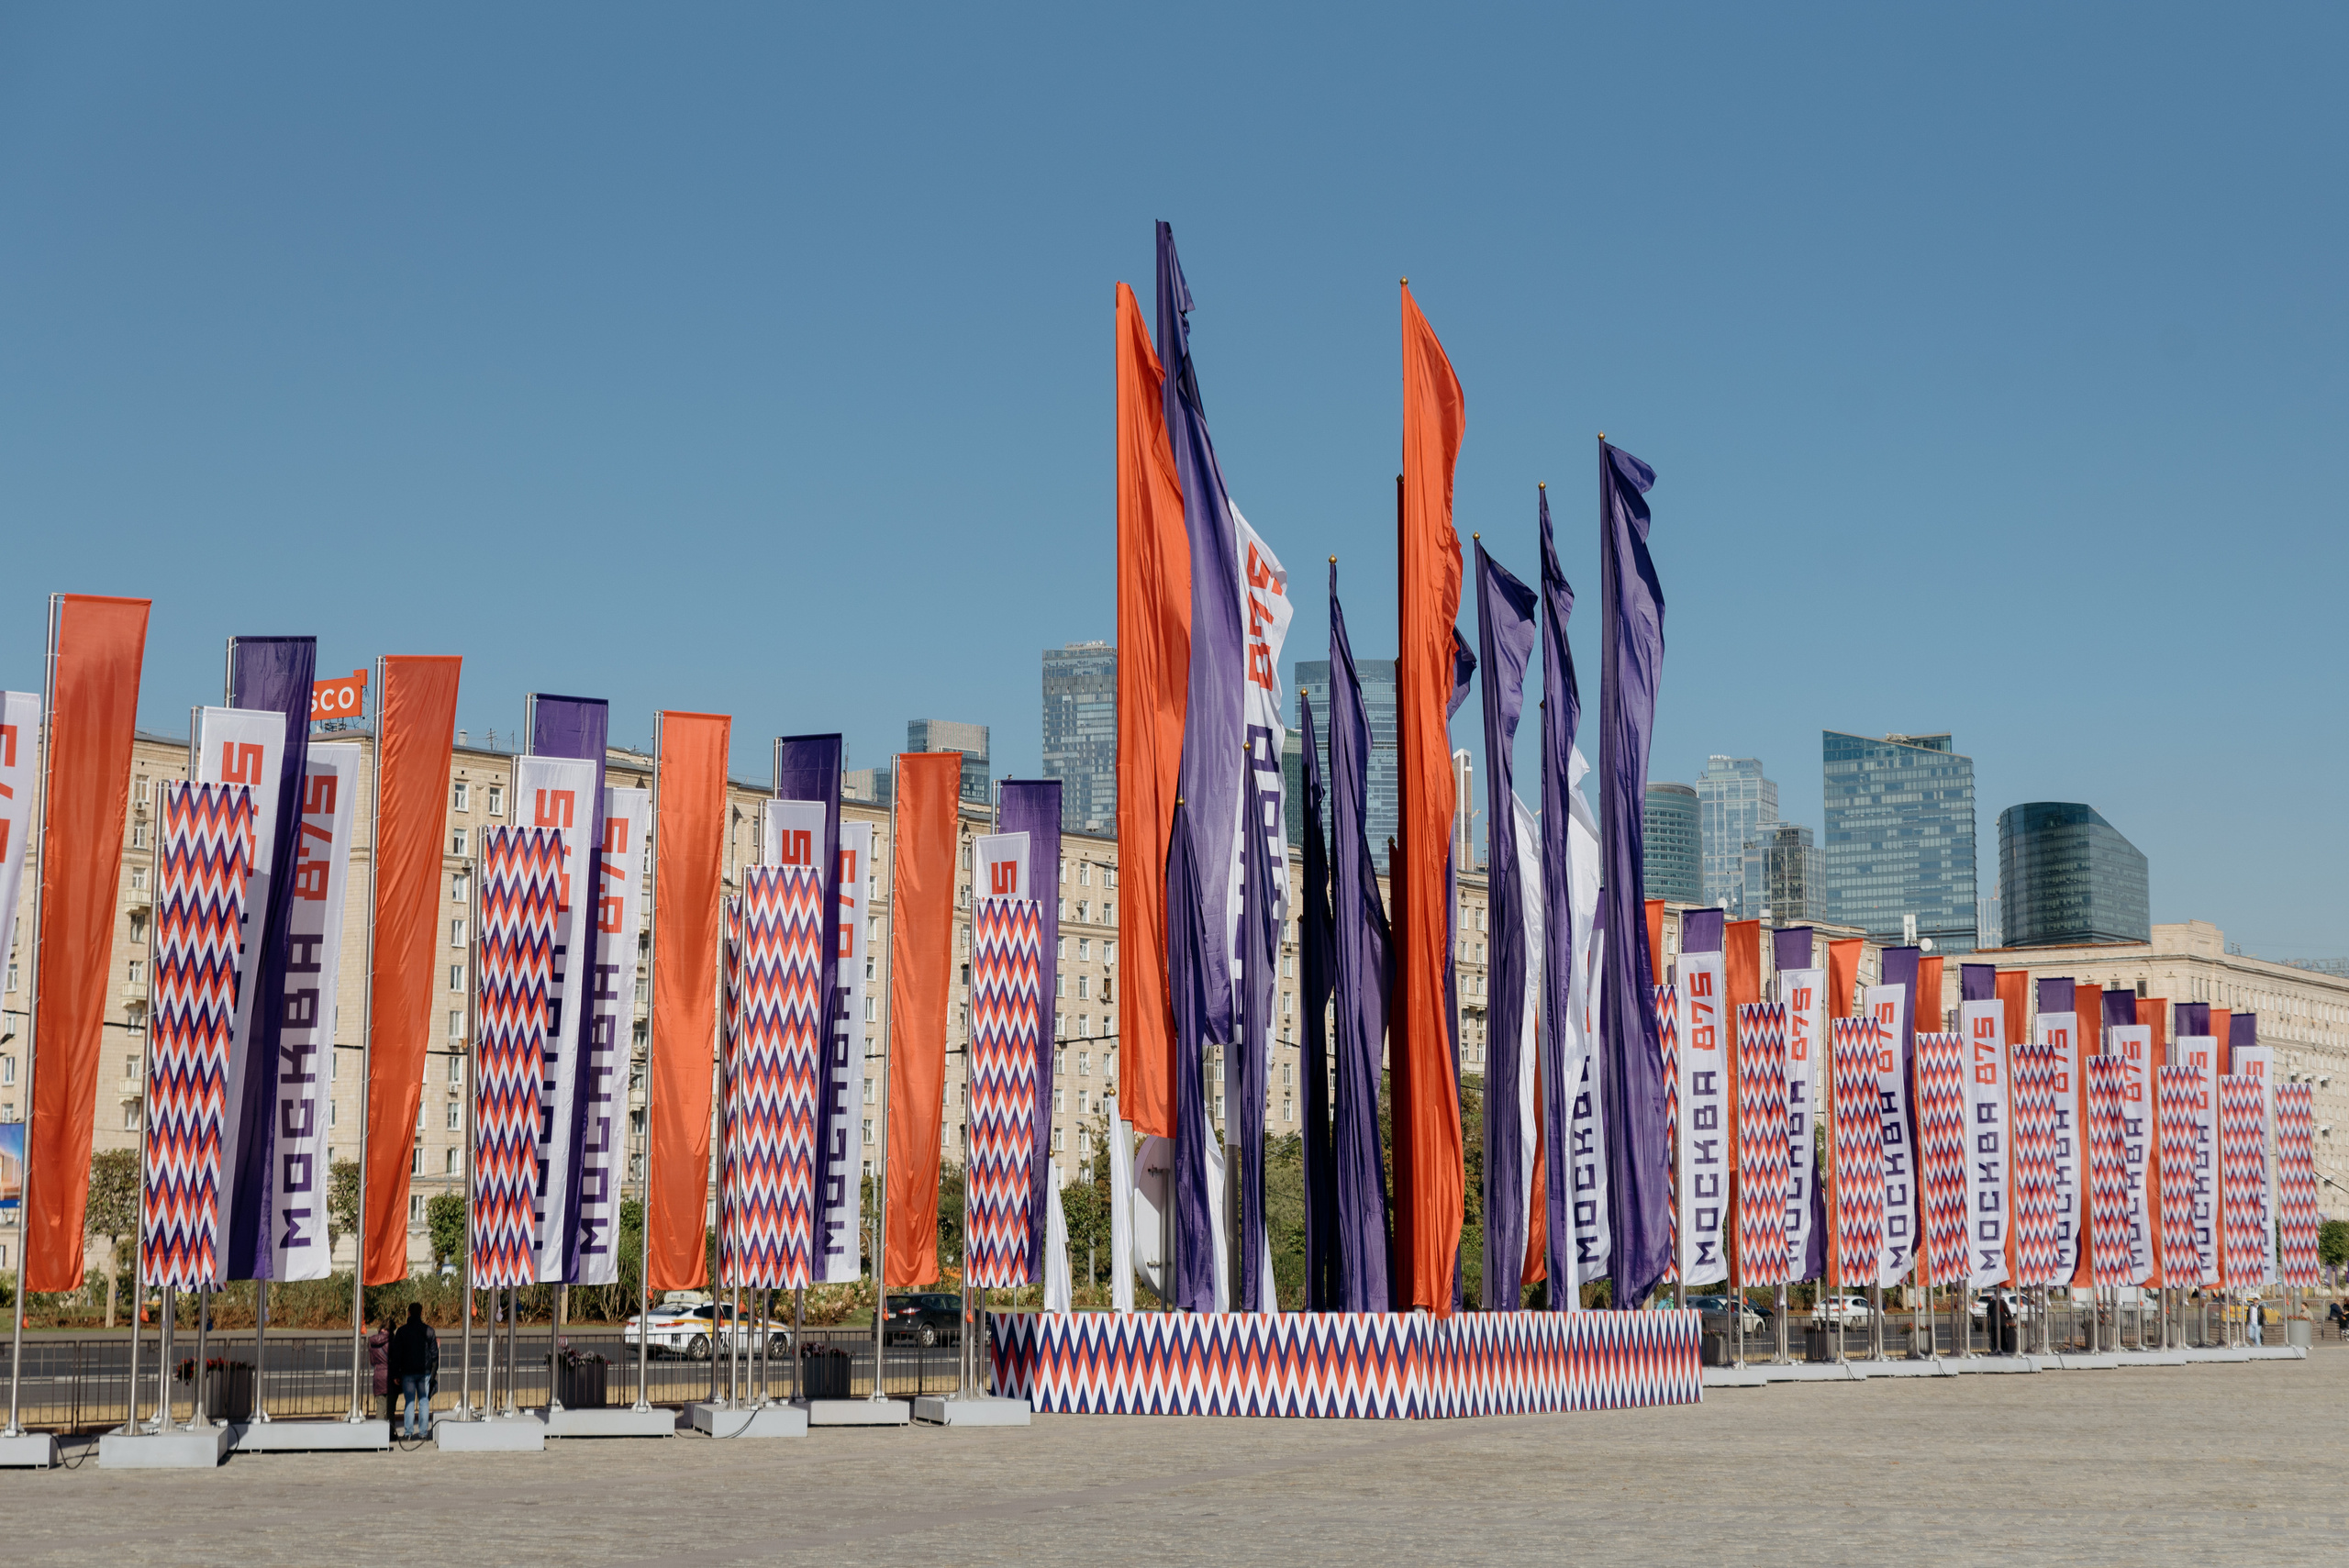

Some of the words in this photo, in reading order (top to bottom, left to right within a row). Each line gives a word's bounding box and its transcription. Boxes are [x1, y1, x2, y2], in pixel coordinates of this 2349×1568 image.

[1248, 541, 1283, 692] 875
[294, 775, 339, 901] 875
[1689, 972, 1716, 1051] 875
[1790, 987, 1812, 1062] 875
[1876, 1002, 1895, 1073] 875
[1974, 1017, 1998, 1085] 875
[2122, 1040, 2143, 1103] 875
[279, 934, 323, 1250] МОСКВА
[1574, 1055, 1600, 1264] МОСКВ
[1692, 1071, 1720, 1267] МОСКВА
[1880, 1091, 1909, 1270] МОСКВА
[1977, 1102, 2001, 1272] МОСКВА
[2125, 1118, 2144, 1270] МОСКВА
